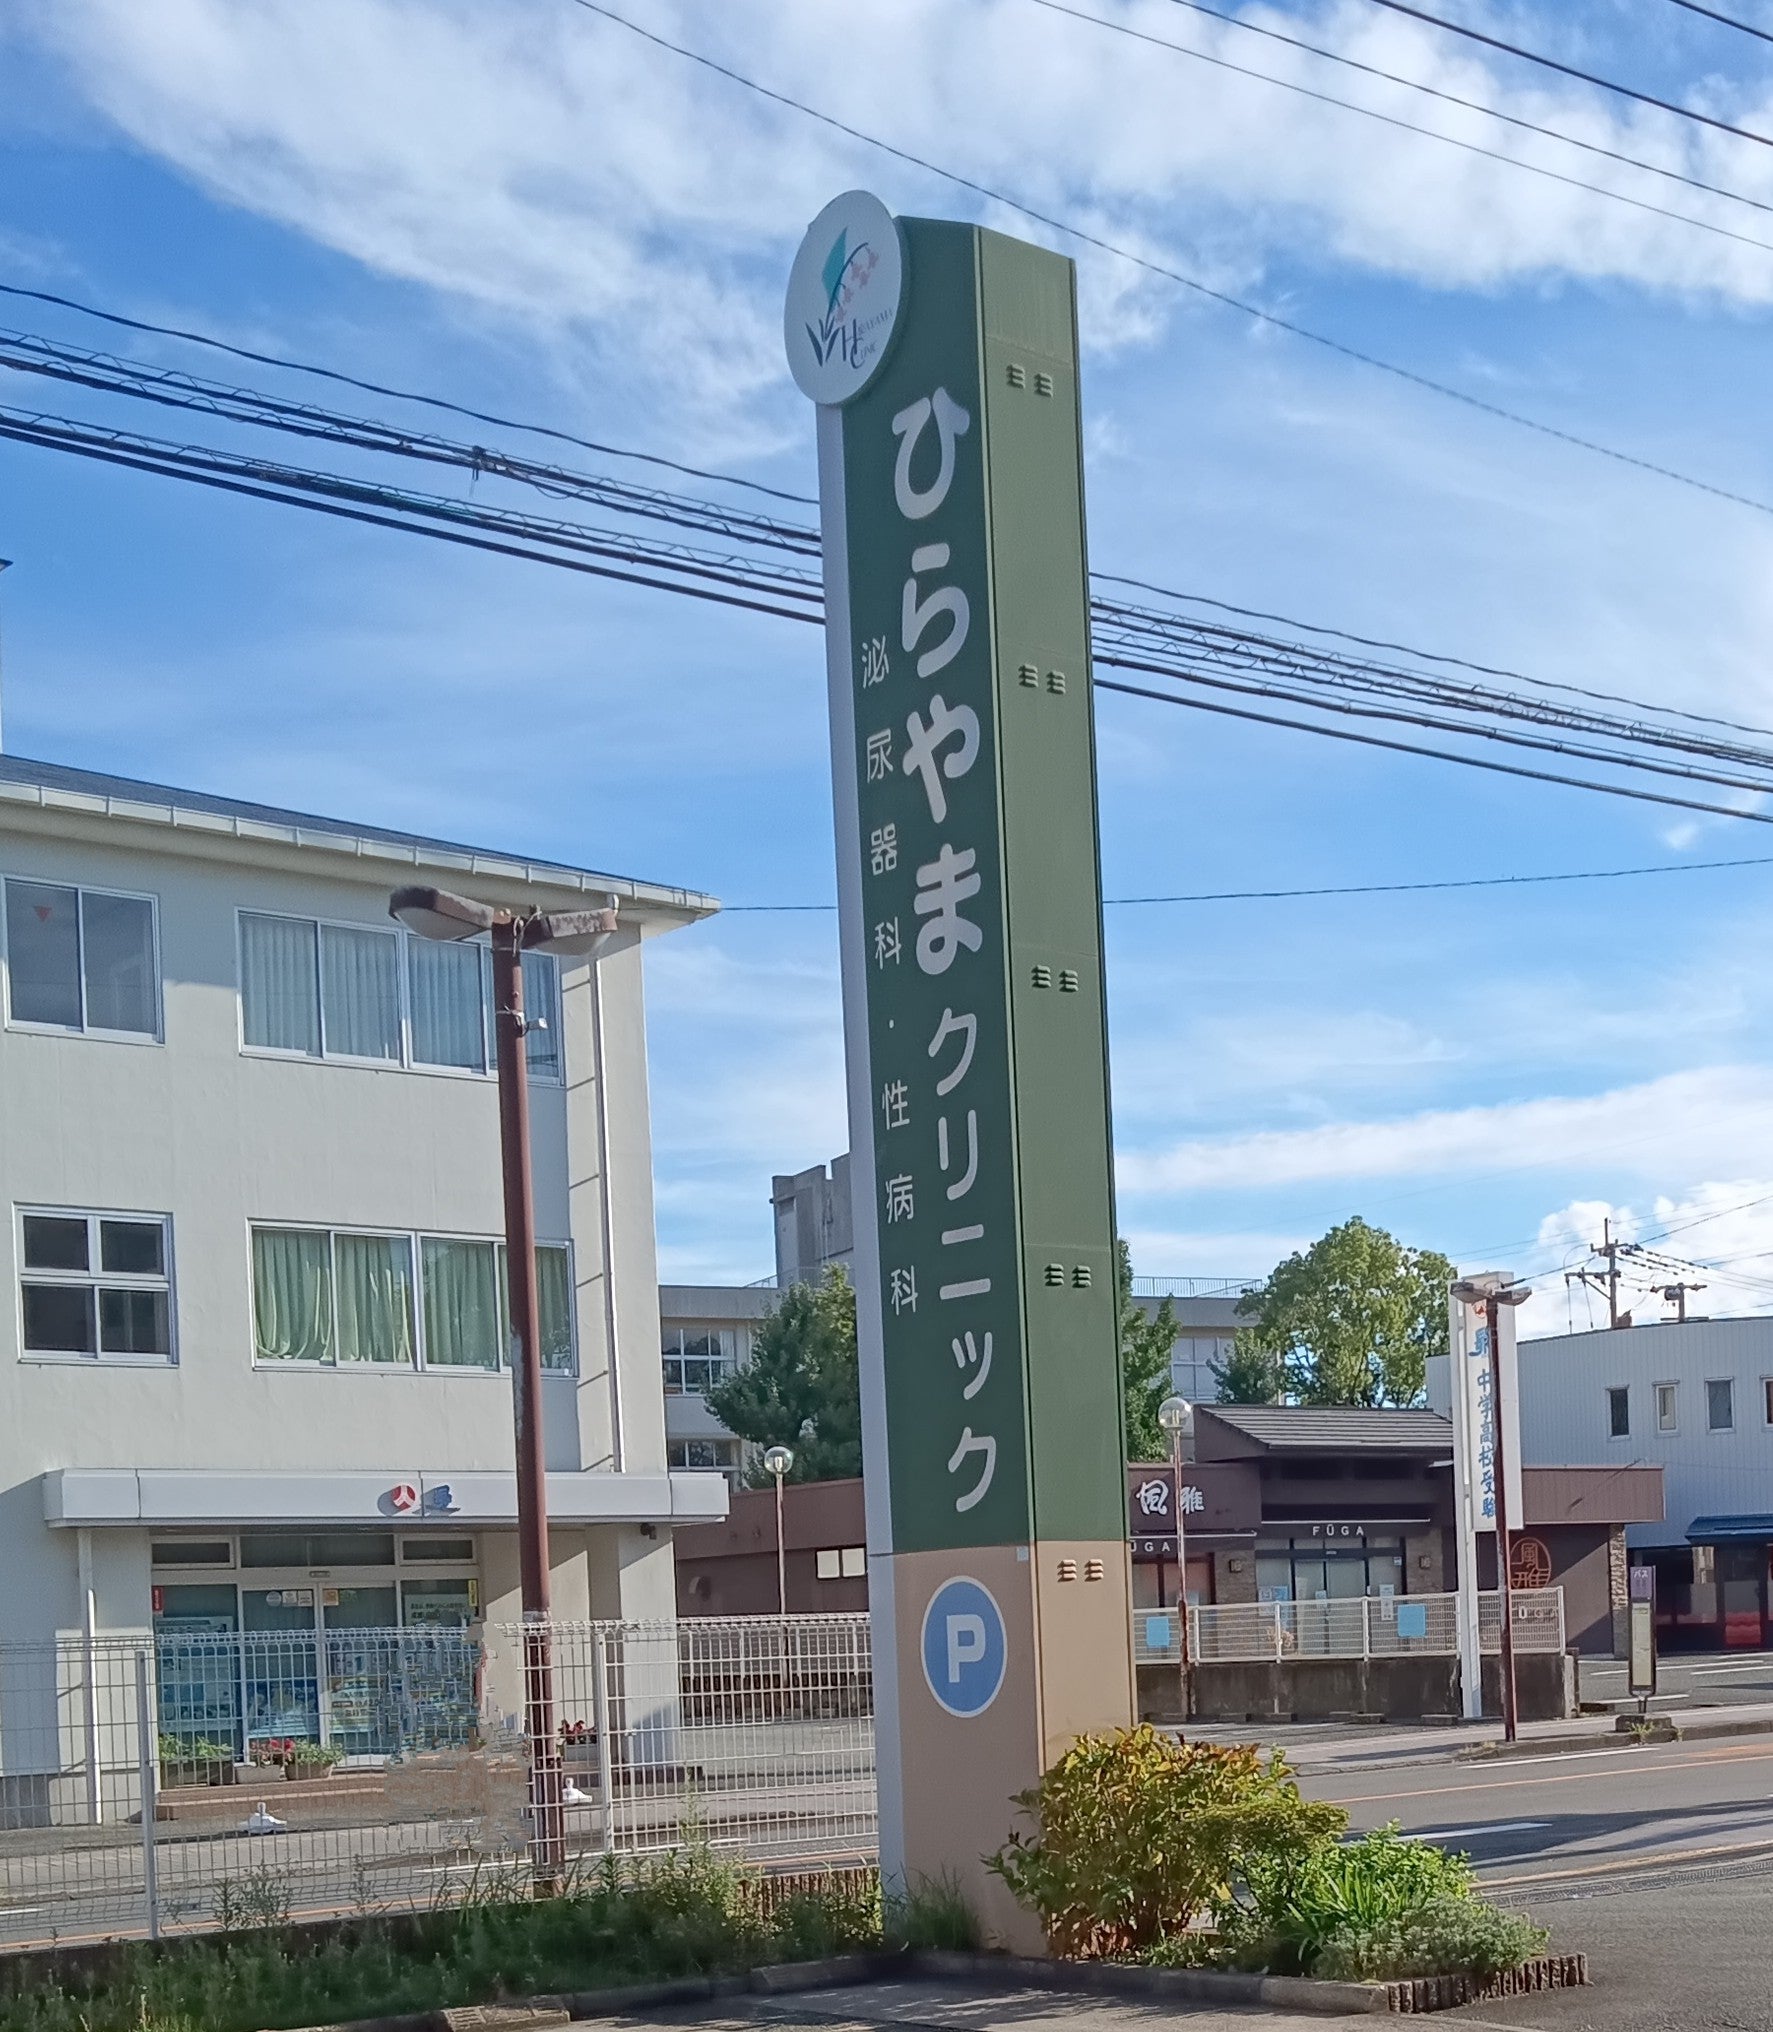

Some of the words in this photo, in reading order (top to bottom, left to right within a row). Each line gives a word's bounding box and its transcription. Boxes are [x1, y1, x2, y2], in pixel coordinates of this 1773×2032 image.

[862, 635, 919, 1316] 泌尿器科・性病科
[892, 386, 997, 1513] ひらやまクリニック
[946, 1613, 986, 1683] P
